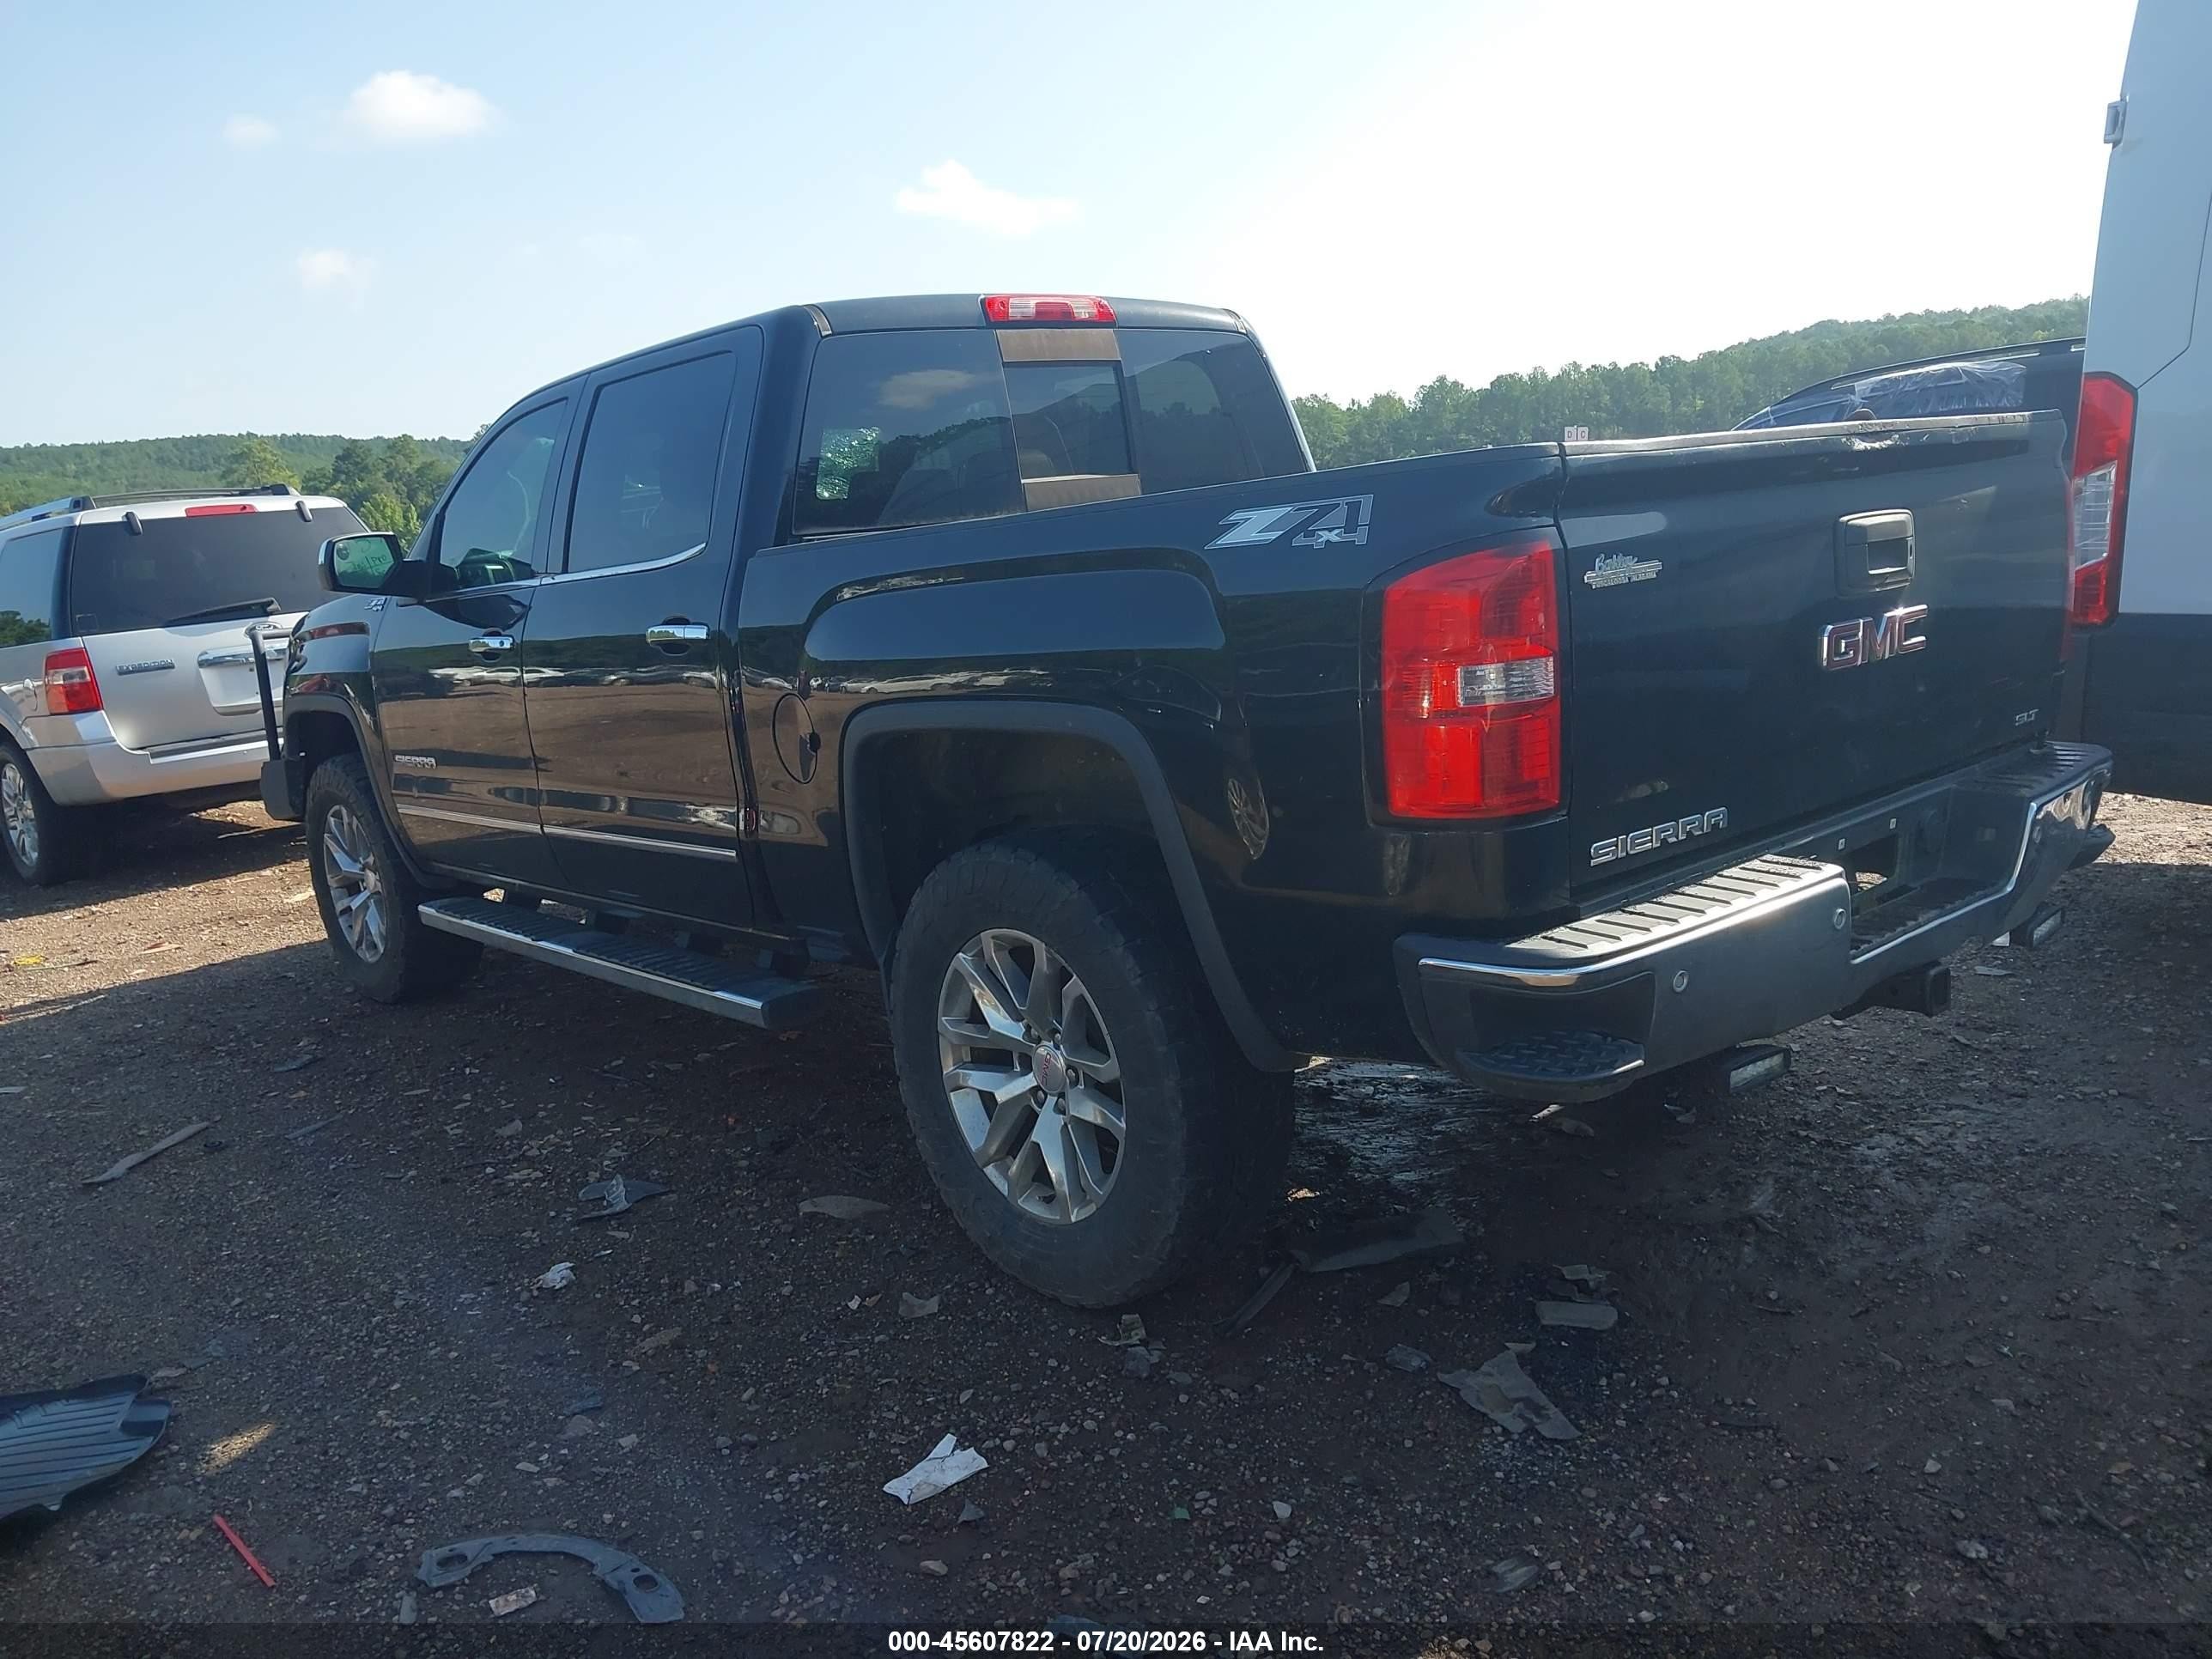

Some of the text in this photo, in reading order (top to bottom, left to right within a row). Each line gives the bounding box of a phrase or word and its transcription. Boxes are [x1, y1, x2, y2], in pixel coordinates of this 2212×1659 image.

[1204, 494, 1374, 550] Z71
[1819, 604, 1929, 671] GMC
[116, 658, 174, 674] EXPEDITION
[1590, 806, 1728, 867] SIERRA
[1041, 1052, 1052, 1086] GMC
